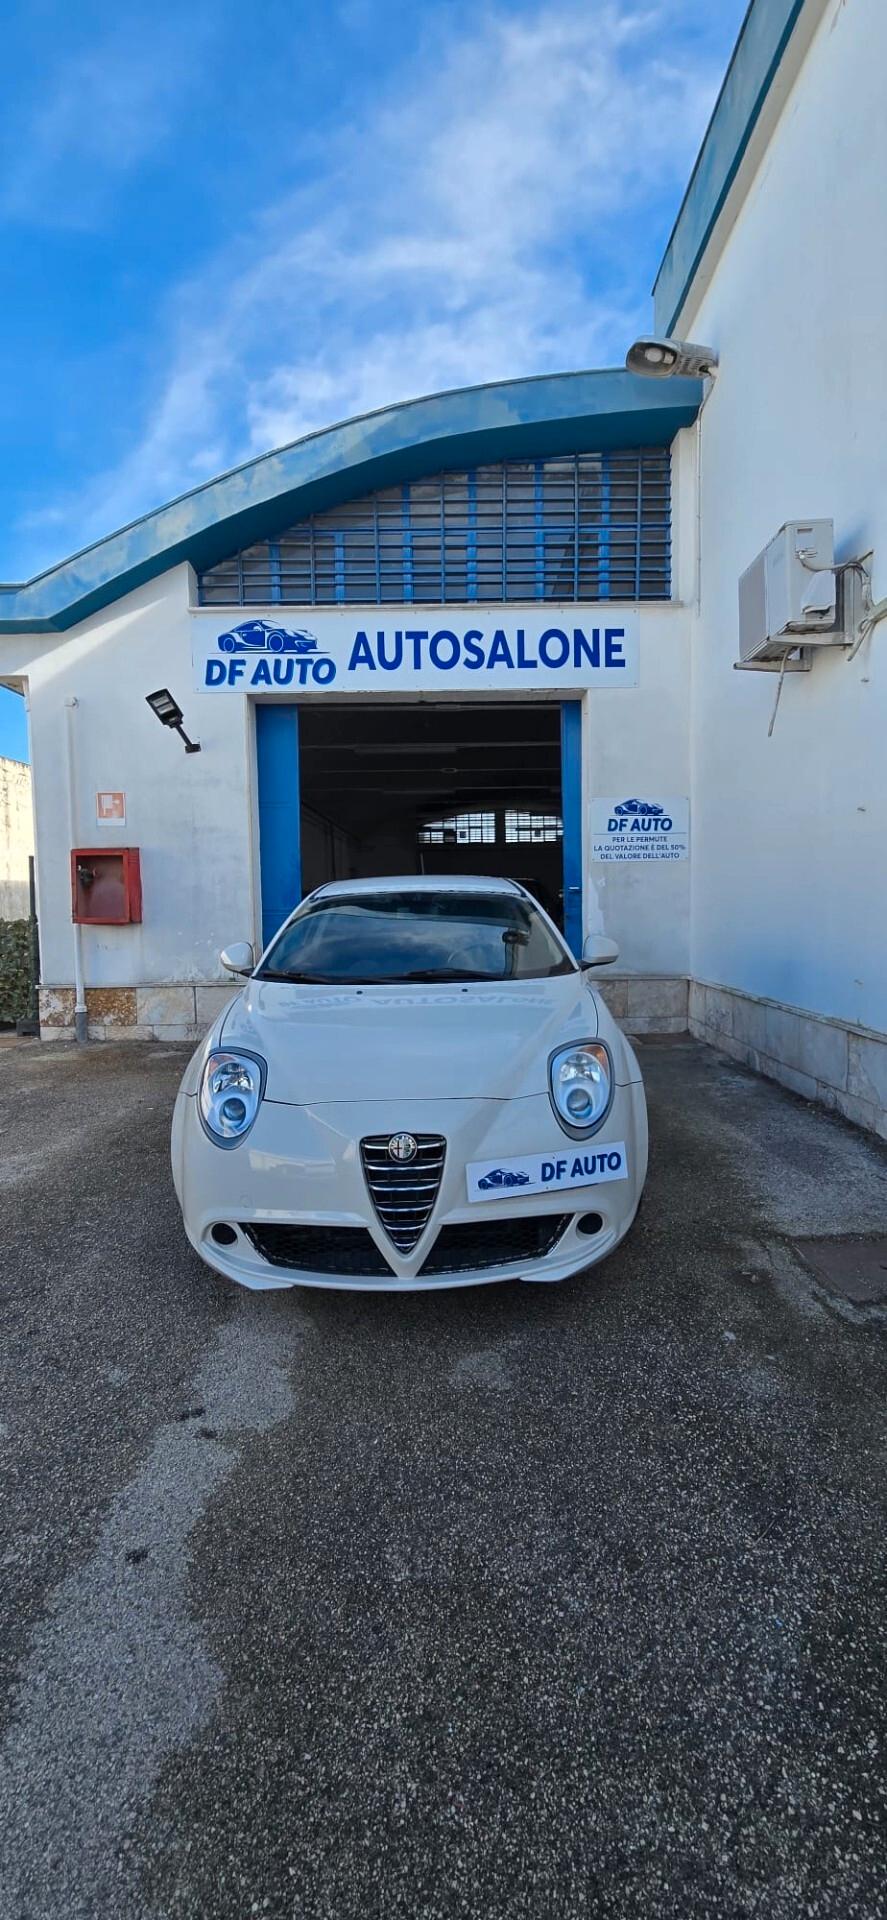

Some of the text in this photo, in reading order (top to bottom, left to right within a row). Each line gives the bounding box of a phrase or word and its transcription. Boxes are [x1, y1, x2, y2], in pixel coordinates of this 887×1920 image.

[348, 628, 626, 671] AUTOSALONE
[205, 658, 337, 686] DF AUTO
[608, 818, 673, 832] DF AUTO
[541, 1152, 622, 1182] DF AUTO
